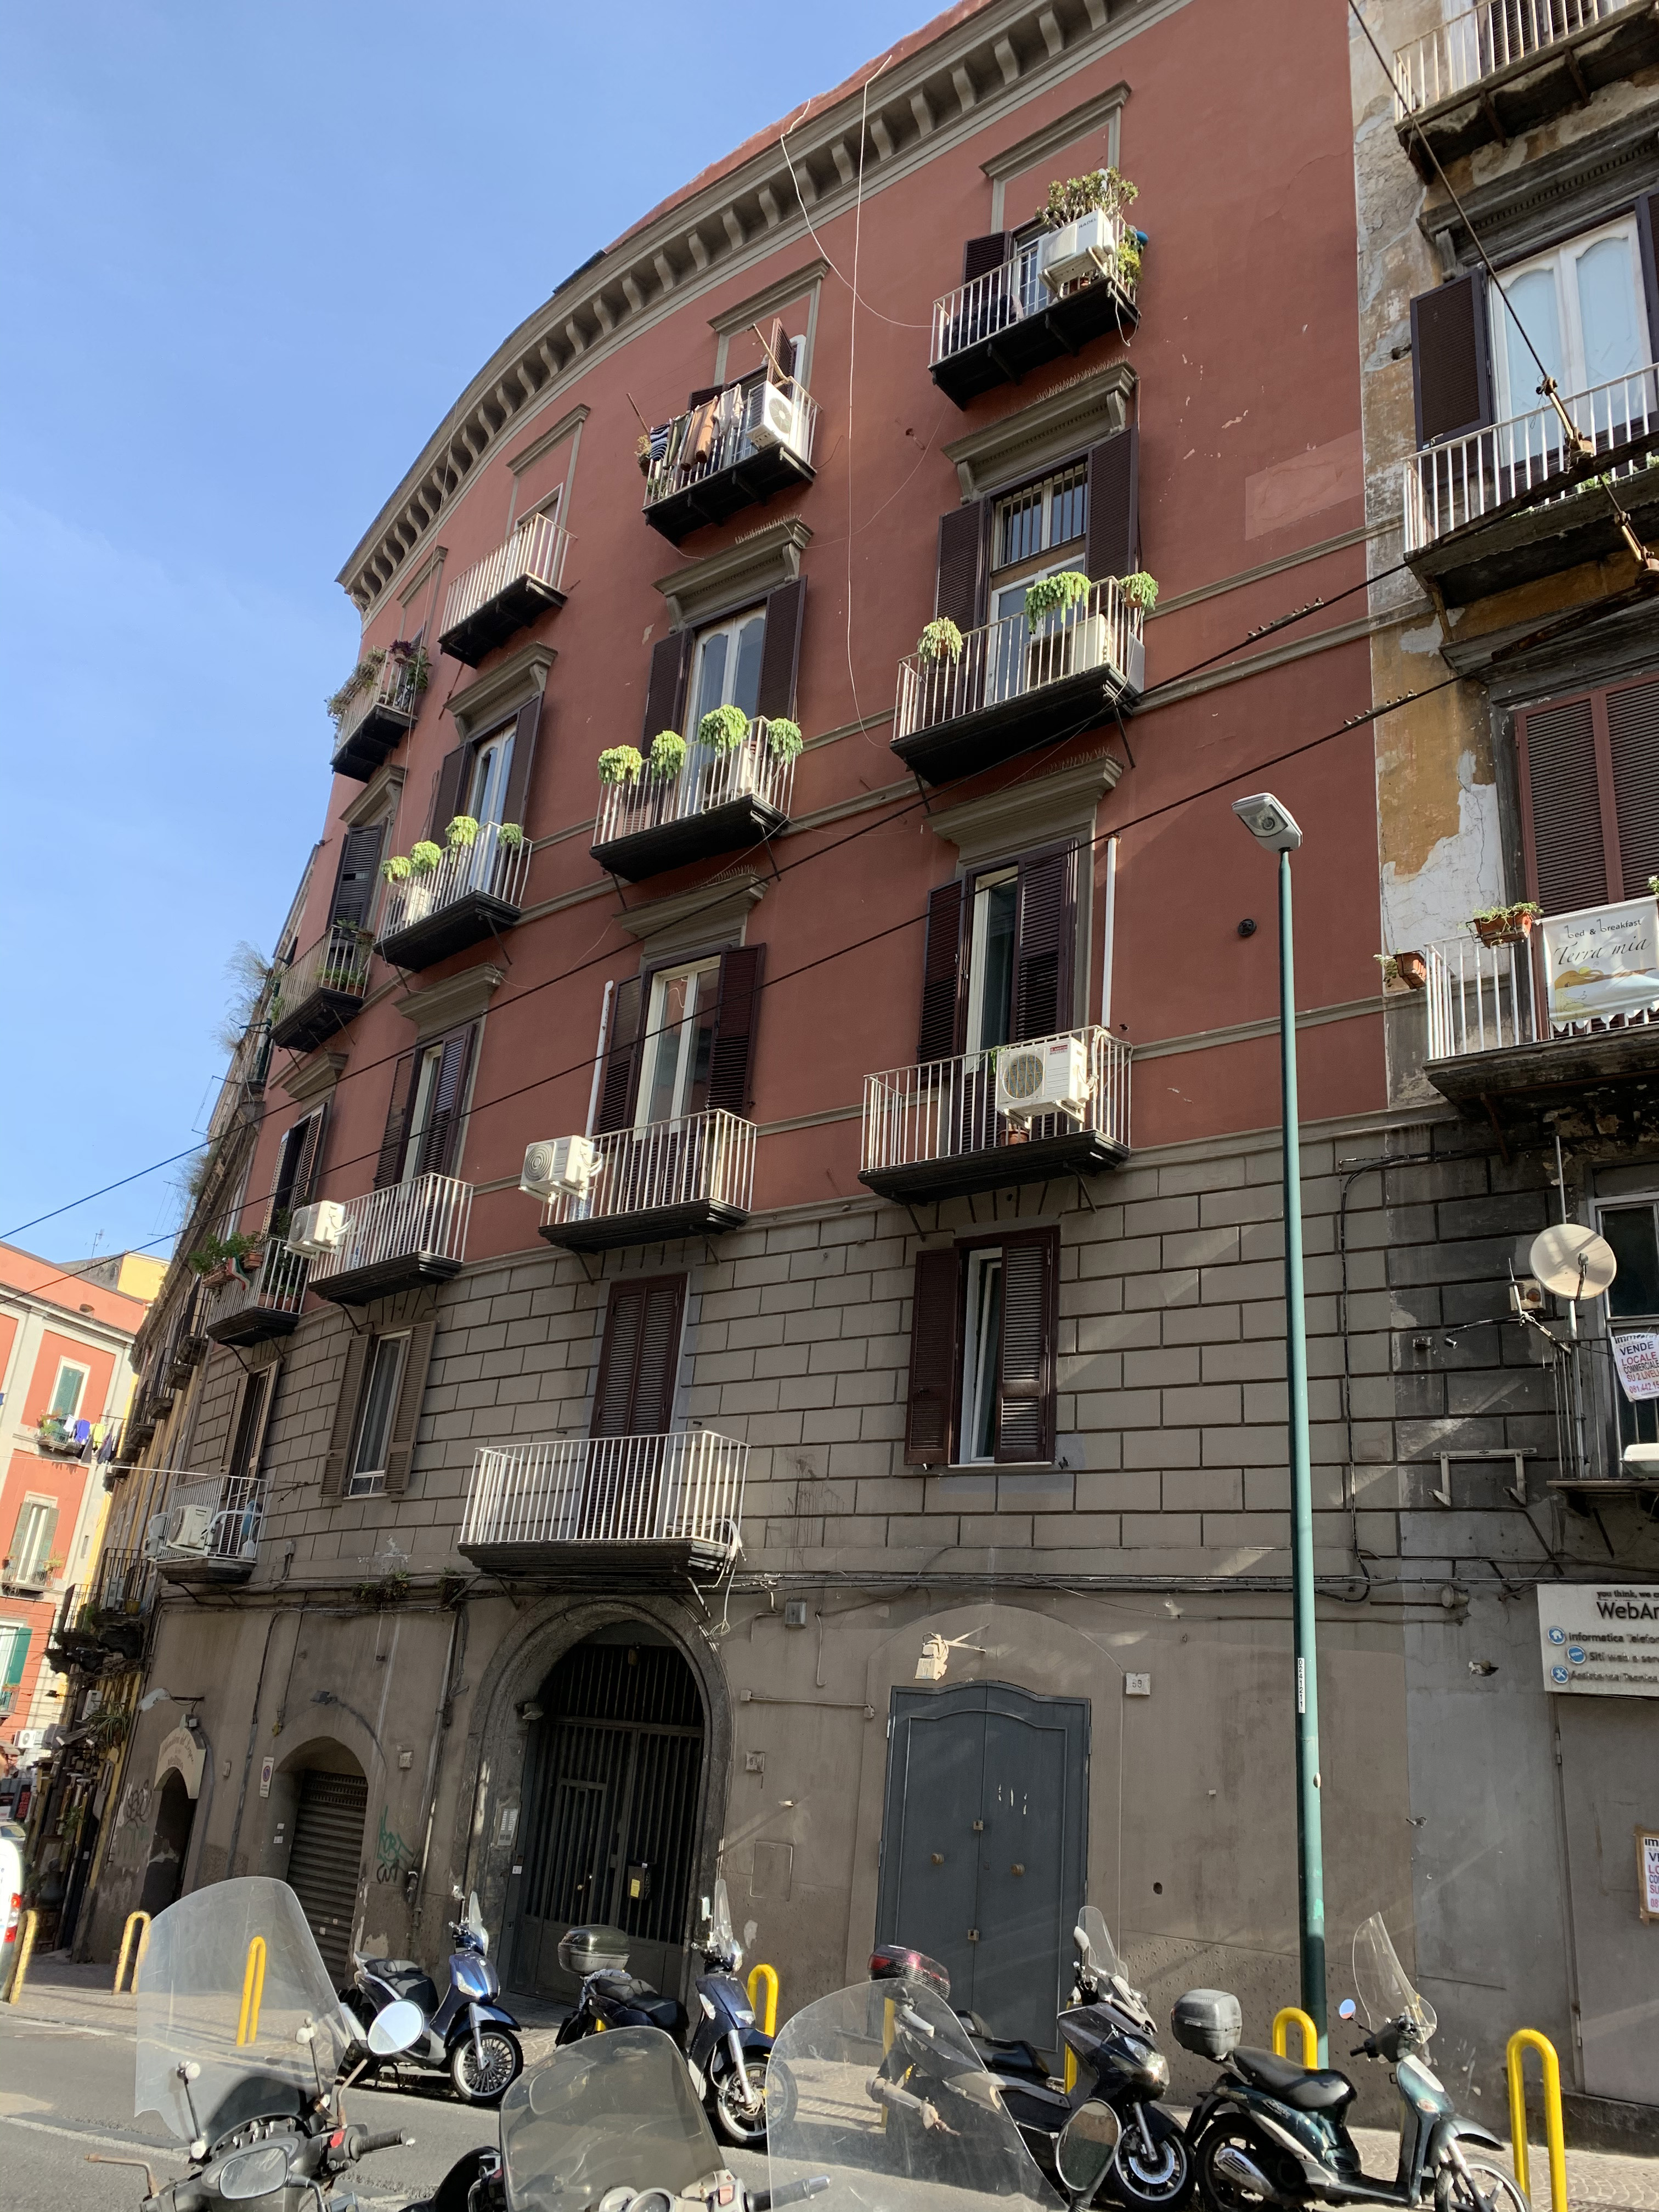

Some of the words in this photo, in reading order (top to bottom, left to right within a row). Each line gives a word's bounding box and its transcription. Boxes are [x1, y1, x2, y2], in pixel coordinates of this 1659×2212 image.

[1564, 925, 1585, 938] bed
[1596, 919, 1641, 932] breakfast
[1554, 941, 1607, 965] Terra
[1612, 936, 1651, 955] mia
[1620, 1341, 1654, 1356] VENDE
[1621, 1352, 1658, 1366] LOCALE
[1623, 1360, 1659, 1374] COMMERCIALE
[1627, 1373, 1635, 1382] SU
[1636, 1373, 1641, 1381] 2
[1596, 1592, 1612, 1600] you
[1569, 1632, 1623, 1642] Informatica
[1589, 1652, 1604, 1661] Siti
